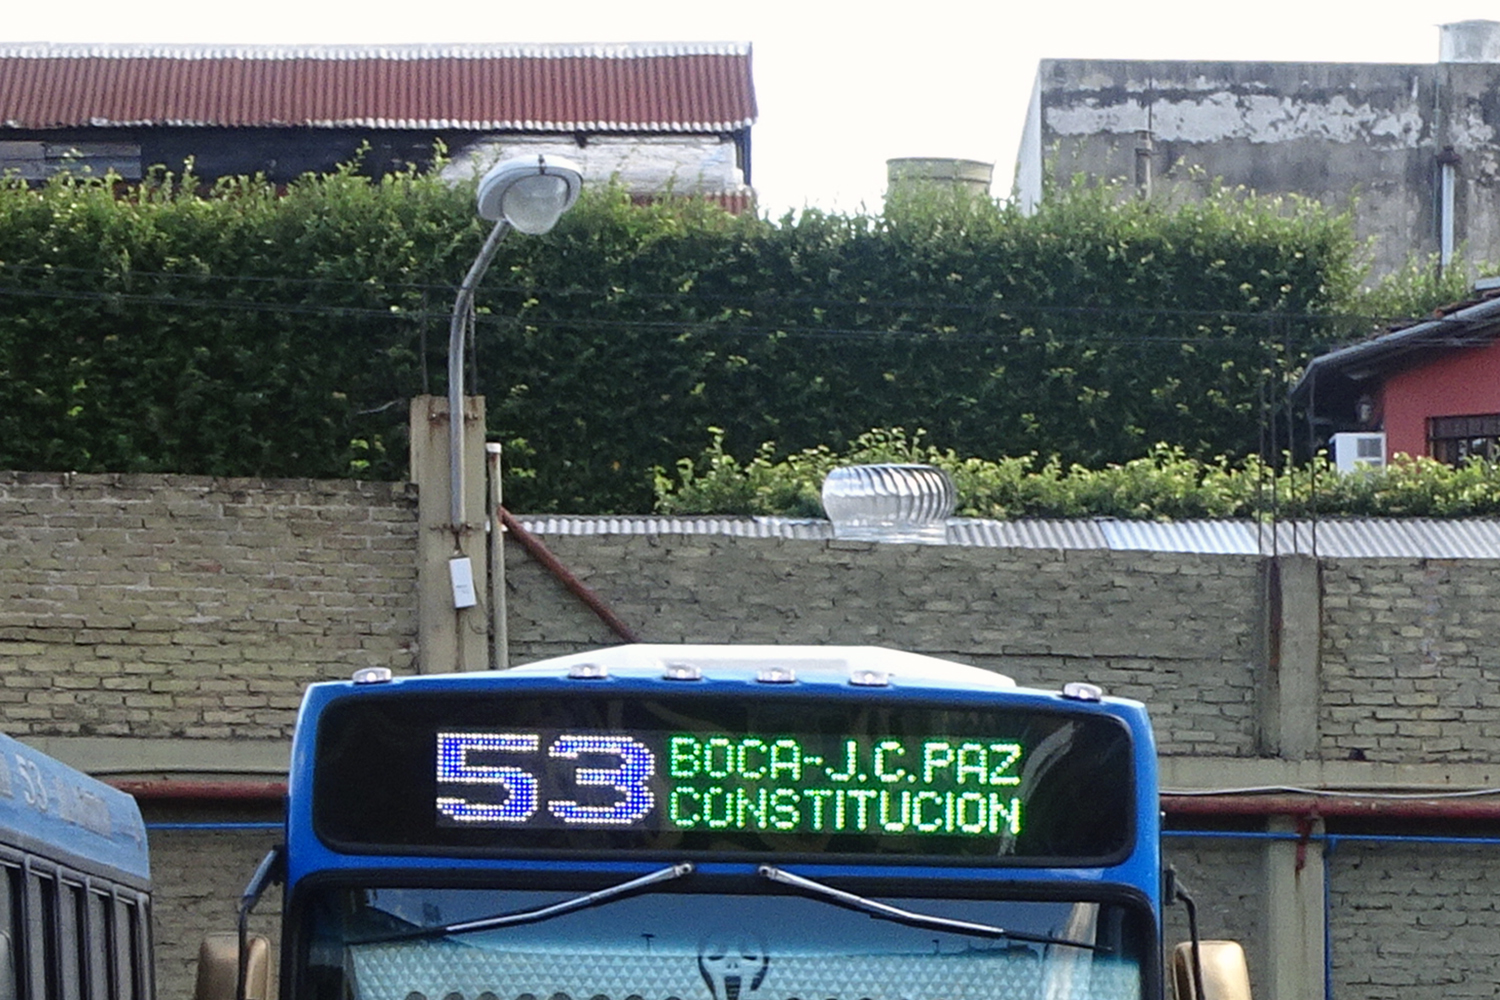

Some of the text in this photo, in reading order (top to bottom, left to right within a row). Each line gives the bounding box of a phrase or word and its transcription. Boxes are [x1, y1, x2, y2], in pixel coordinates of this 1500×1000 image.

[434, 731, 656, 824] 53
[669, 734, 1023, 786] BOCA-J.C.PAZ
[668, 787, 1021, 834] CONSTITUCION
